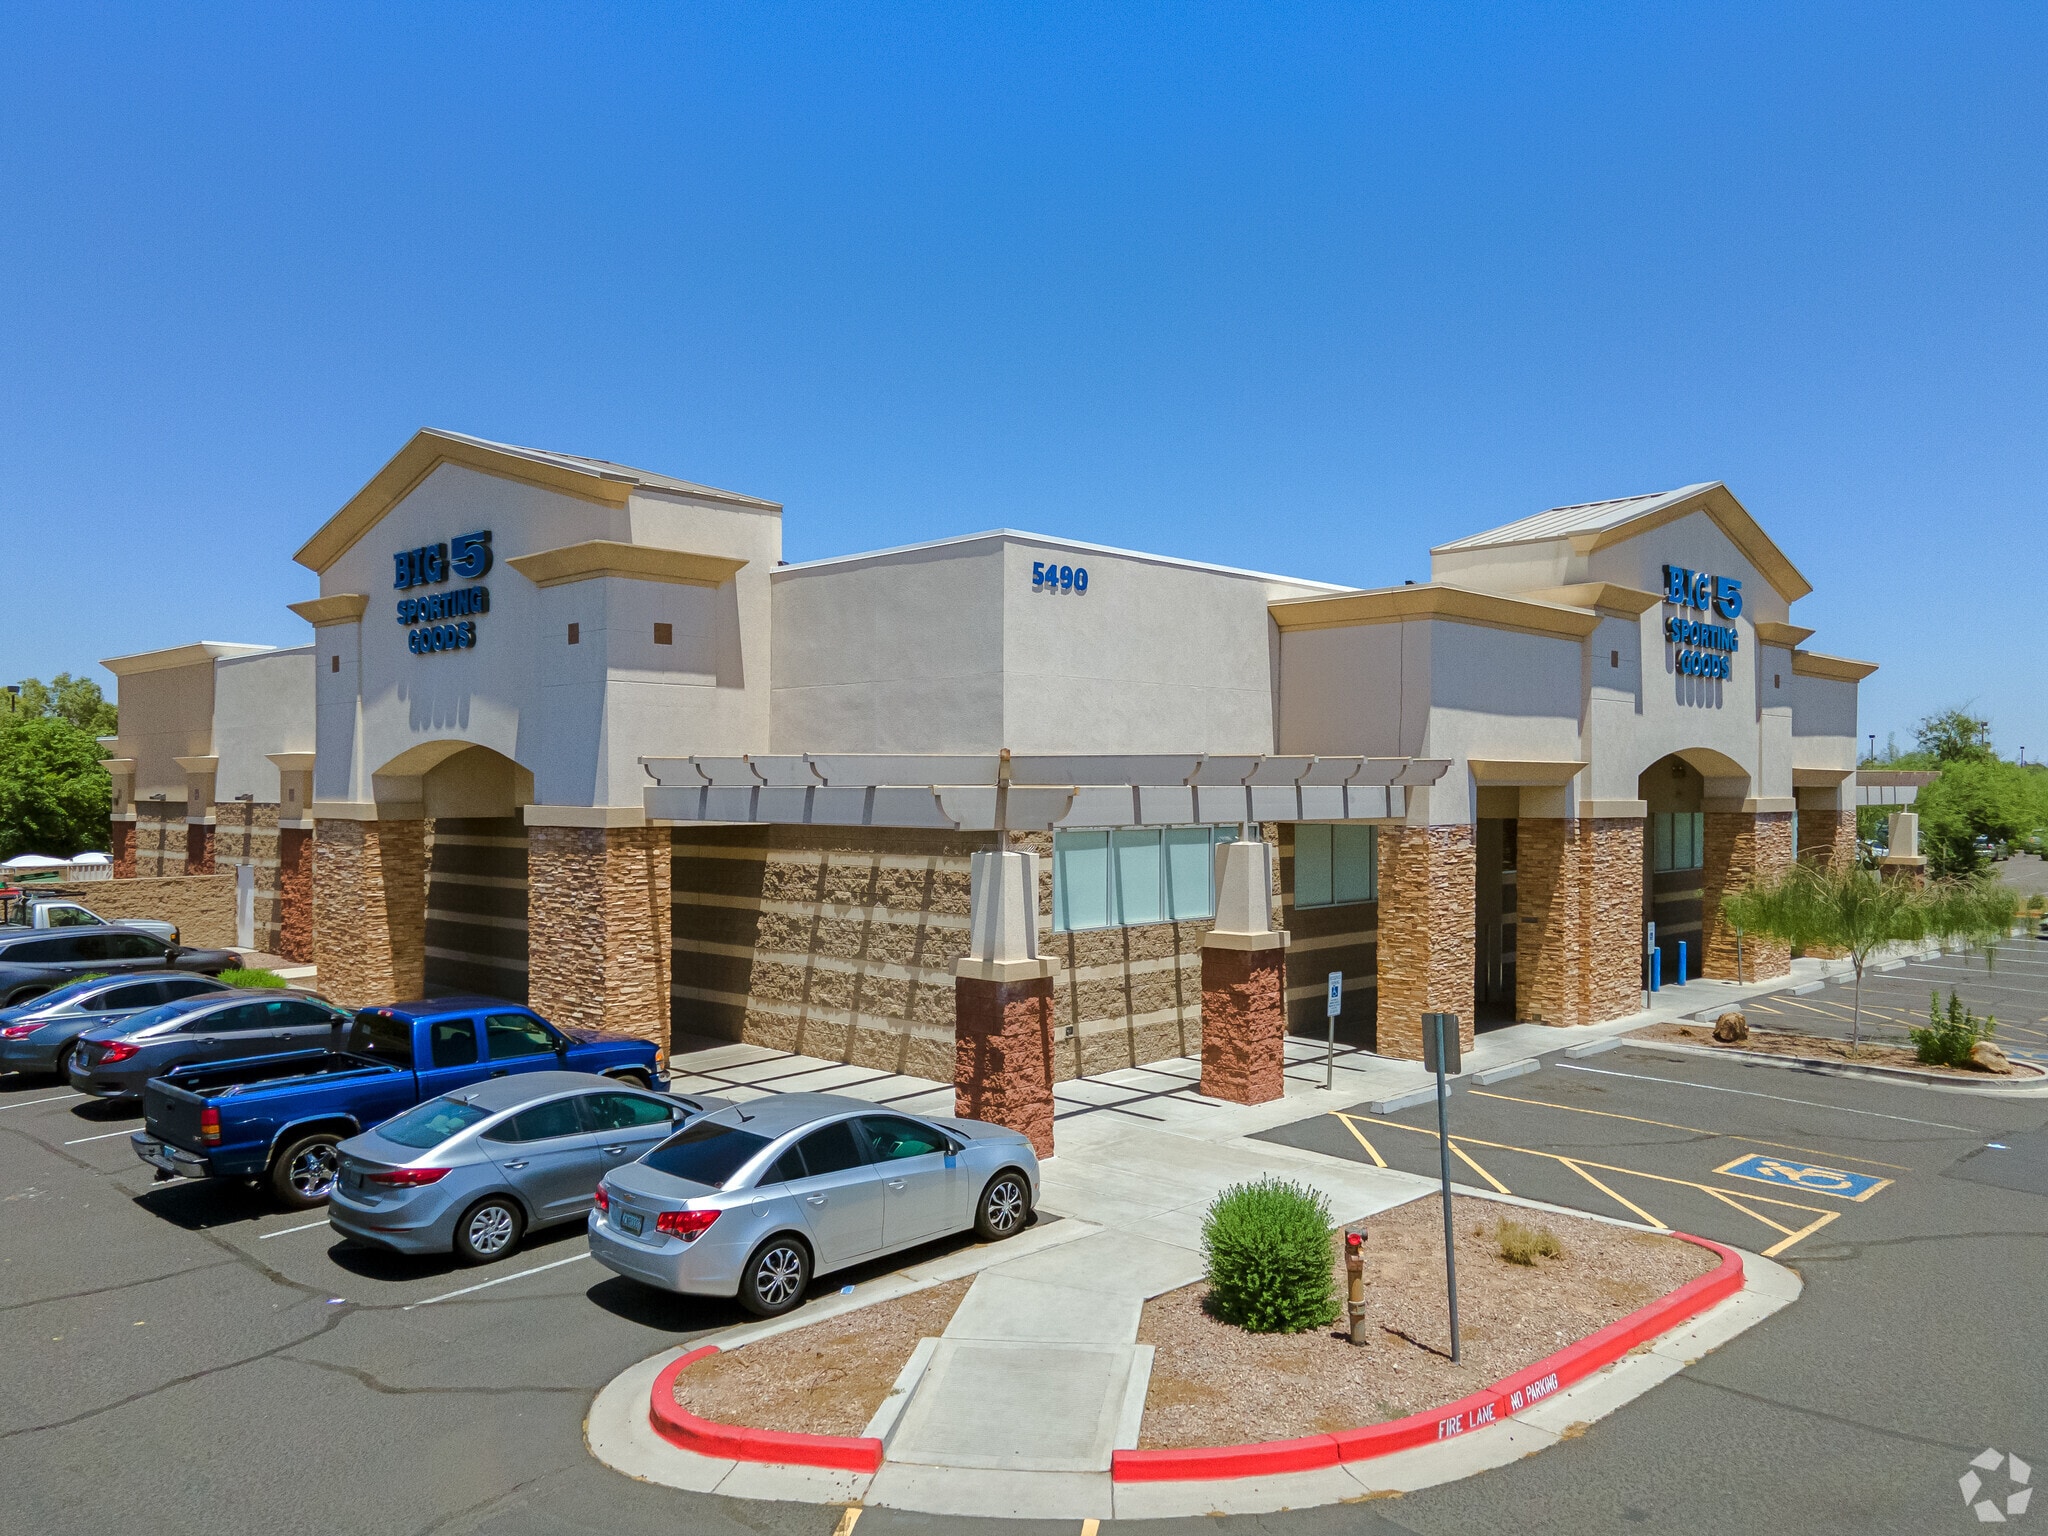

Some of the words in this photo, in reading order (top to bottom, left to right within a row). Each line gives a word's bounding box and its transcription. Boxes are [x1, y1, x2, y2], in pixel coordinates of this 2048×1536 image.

[394, 543, 447, 590] BIG
[451, 530, 492, 579] 5
[1032, 561, 1088, 591] 5490
[397, 587, 488, 625] SPORTING
[1664, 565, 1711, 611] BIG
[1712, 576, 1742, 619] 5
[408, 621, 475, 654] GOODS
[1666, 617, 1738, 652] SPORTING
[1677, 649, 1729, 679] GOODS
[1438, 1414, 1463, 1440] FIRE
[1469, 1403, 1496, 1428] LANE
[1510, 1390, 1524, 1411] NO
[1525, 1373, 1558, 1403] PARKING
